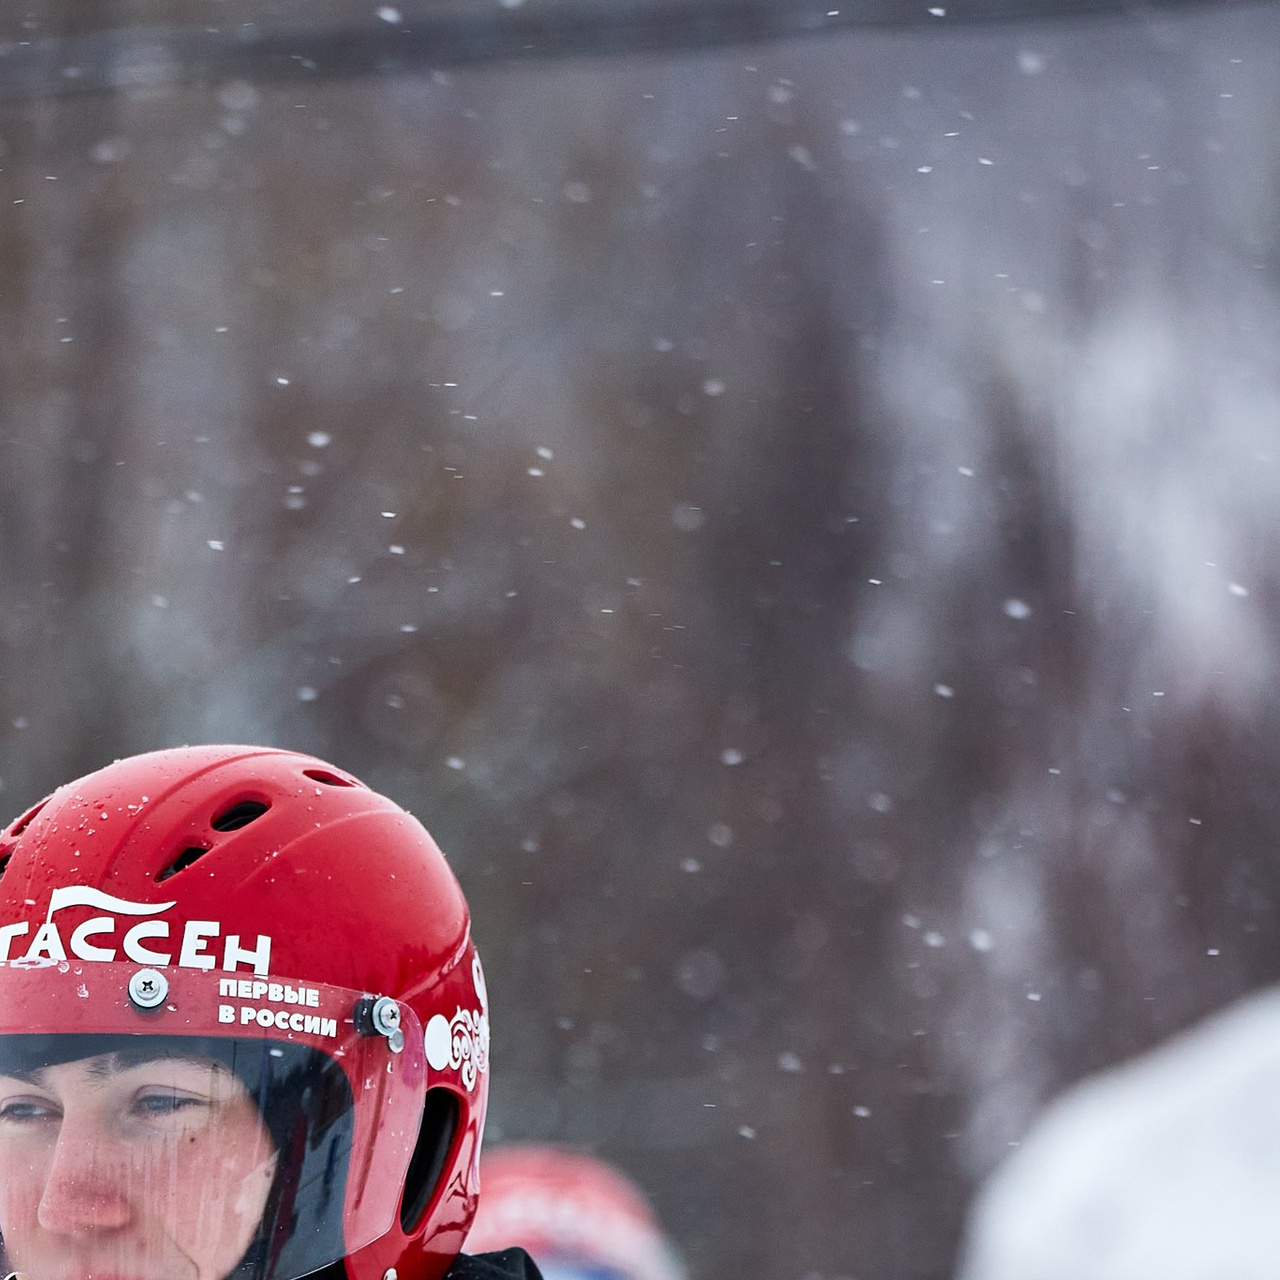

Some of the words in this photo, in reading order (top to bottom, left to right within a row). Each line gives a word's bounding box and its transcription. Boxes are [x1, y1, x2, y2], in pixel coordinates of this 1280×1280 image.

[219, 978, 320, 1008] ПЕРВЫЕ
[218, 1005, 236, 1024] В
[240, 1007, 338, 1038] РОССИИ
